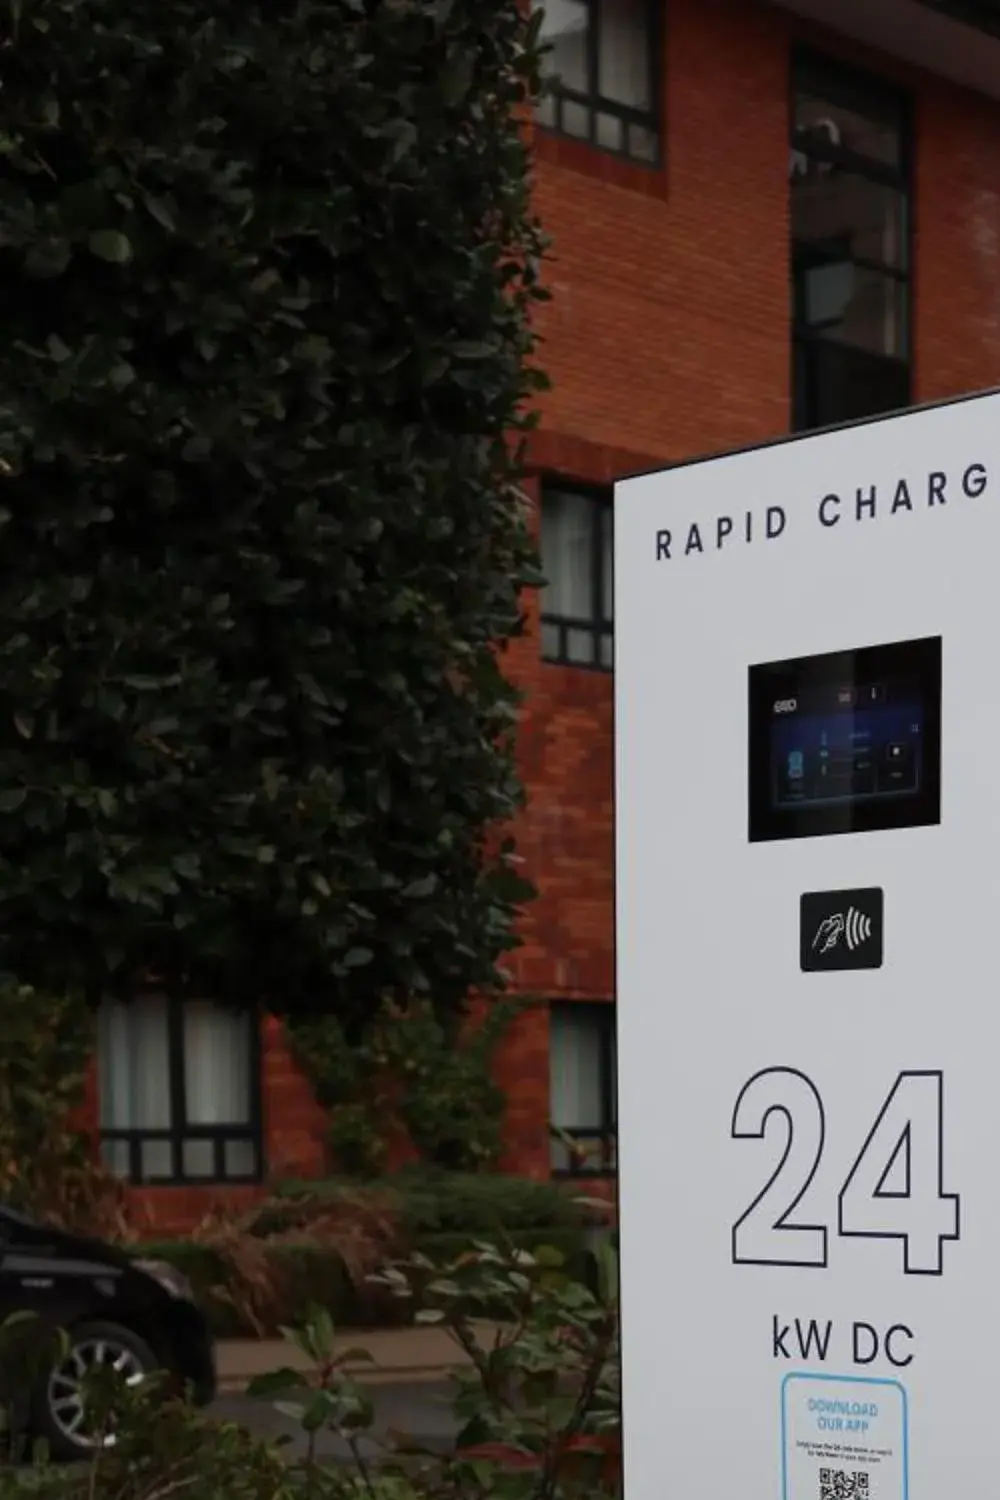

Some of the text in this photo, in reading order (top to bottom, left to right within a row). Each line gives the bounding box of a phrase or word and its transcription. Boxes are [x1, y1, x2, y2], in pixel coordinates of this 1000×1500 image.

[655, 505, 787, 561] RAPID
[731, 1065, 960, 1276] 24
[772, 1313, 914, 1367] kW DC
[807, 1397, 879, 1418] DOWNLOAD
[816, 1415, 869, 1433] OUR APP
